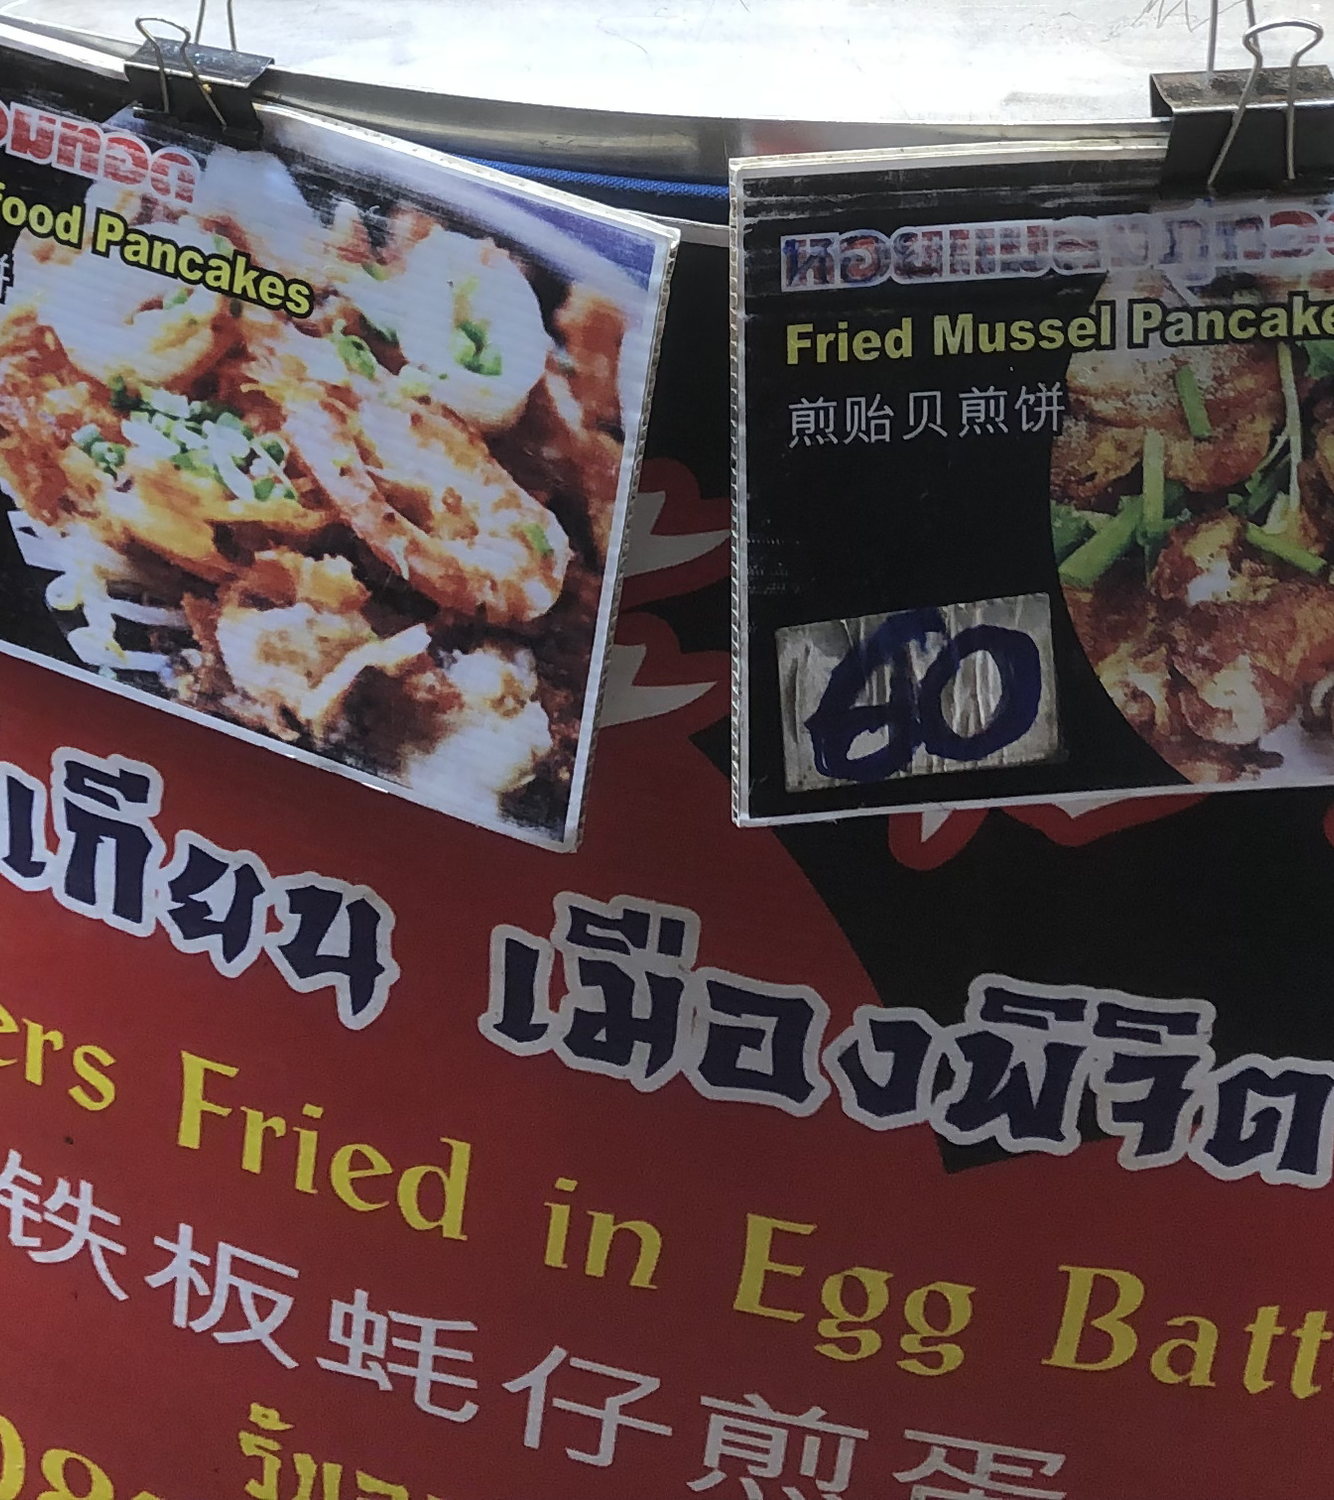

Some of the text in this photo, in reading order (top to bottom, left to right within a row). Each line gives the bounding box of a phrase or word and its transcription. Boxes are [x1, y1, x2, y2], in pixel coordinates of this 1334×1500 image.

[93, 209, 315, 317] Pancakes
[785, 318, 913, 365] Fried
[934, 299, 1114, 357] Mussel
[788, 381, 1066, 450] 煎贻贝煎饼
[176, 1050, 472, 1243] Fried
[542, 1177, 664, 1291] in
[731, 1213, 977, 1377] Egg
